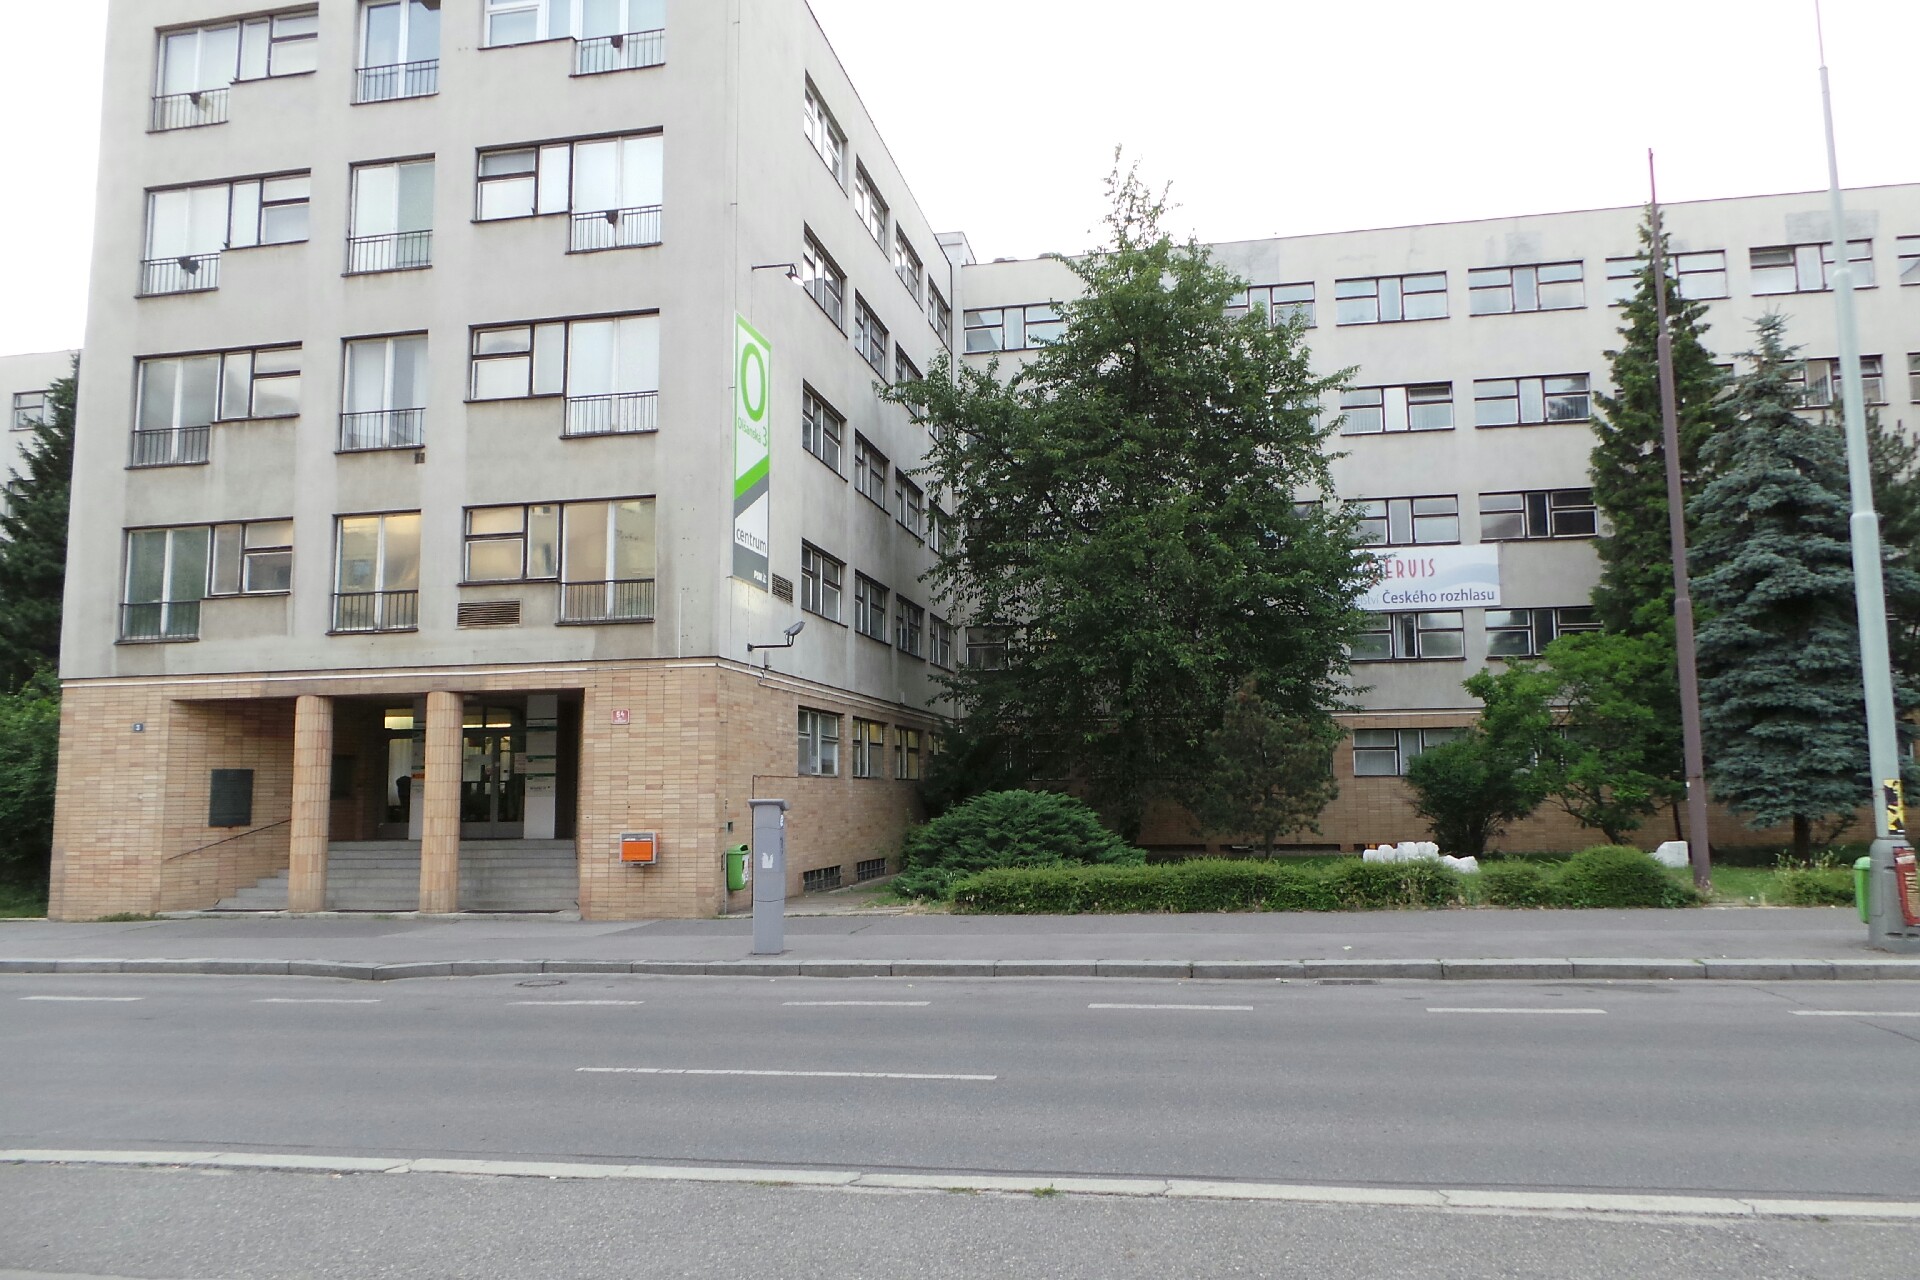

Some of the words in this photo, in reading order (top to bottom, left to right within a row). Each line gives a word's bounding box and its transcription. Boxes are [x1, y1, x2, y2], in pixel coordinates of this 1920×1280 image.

[762, 426, 767, 447] 3
[736, 526, 767, 555] centrum
[1382, 589, 1437, 604] Českého
[1440, 588, 1495, 603] rozhlasu
